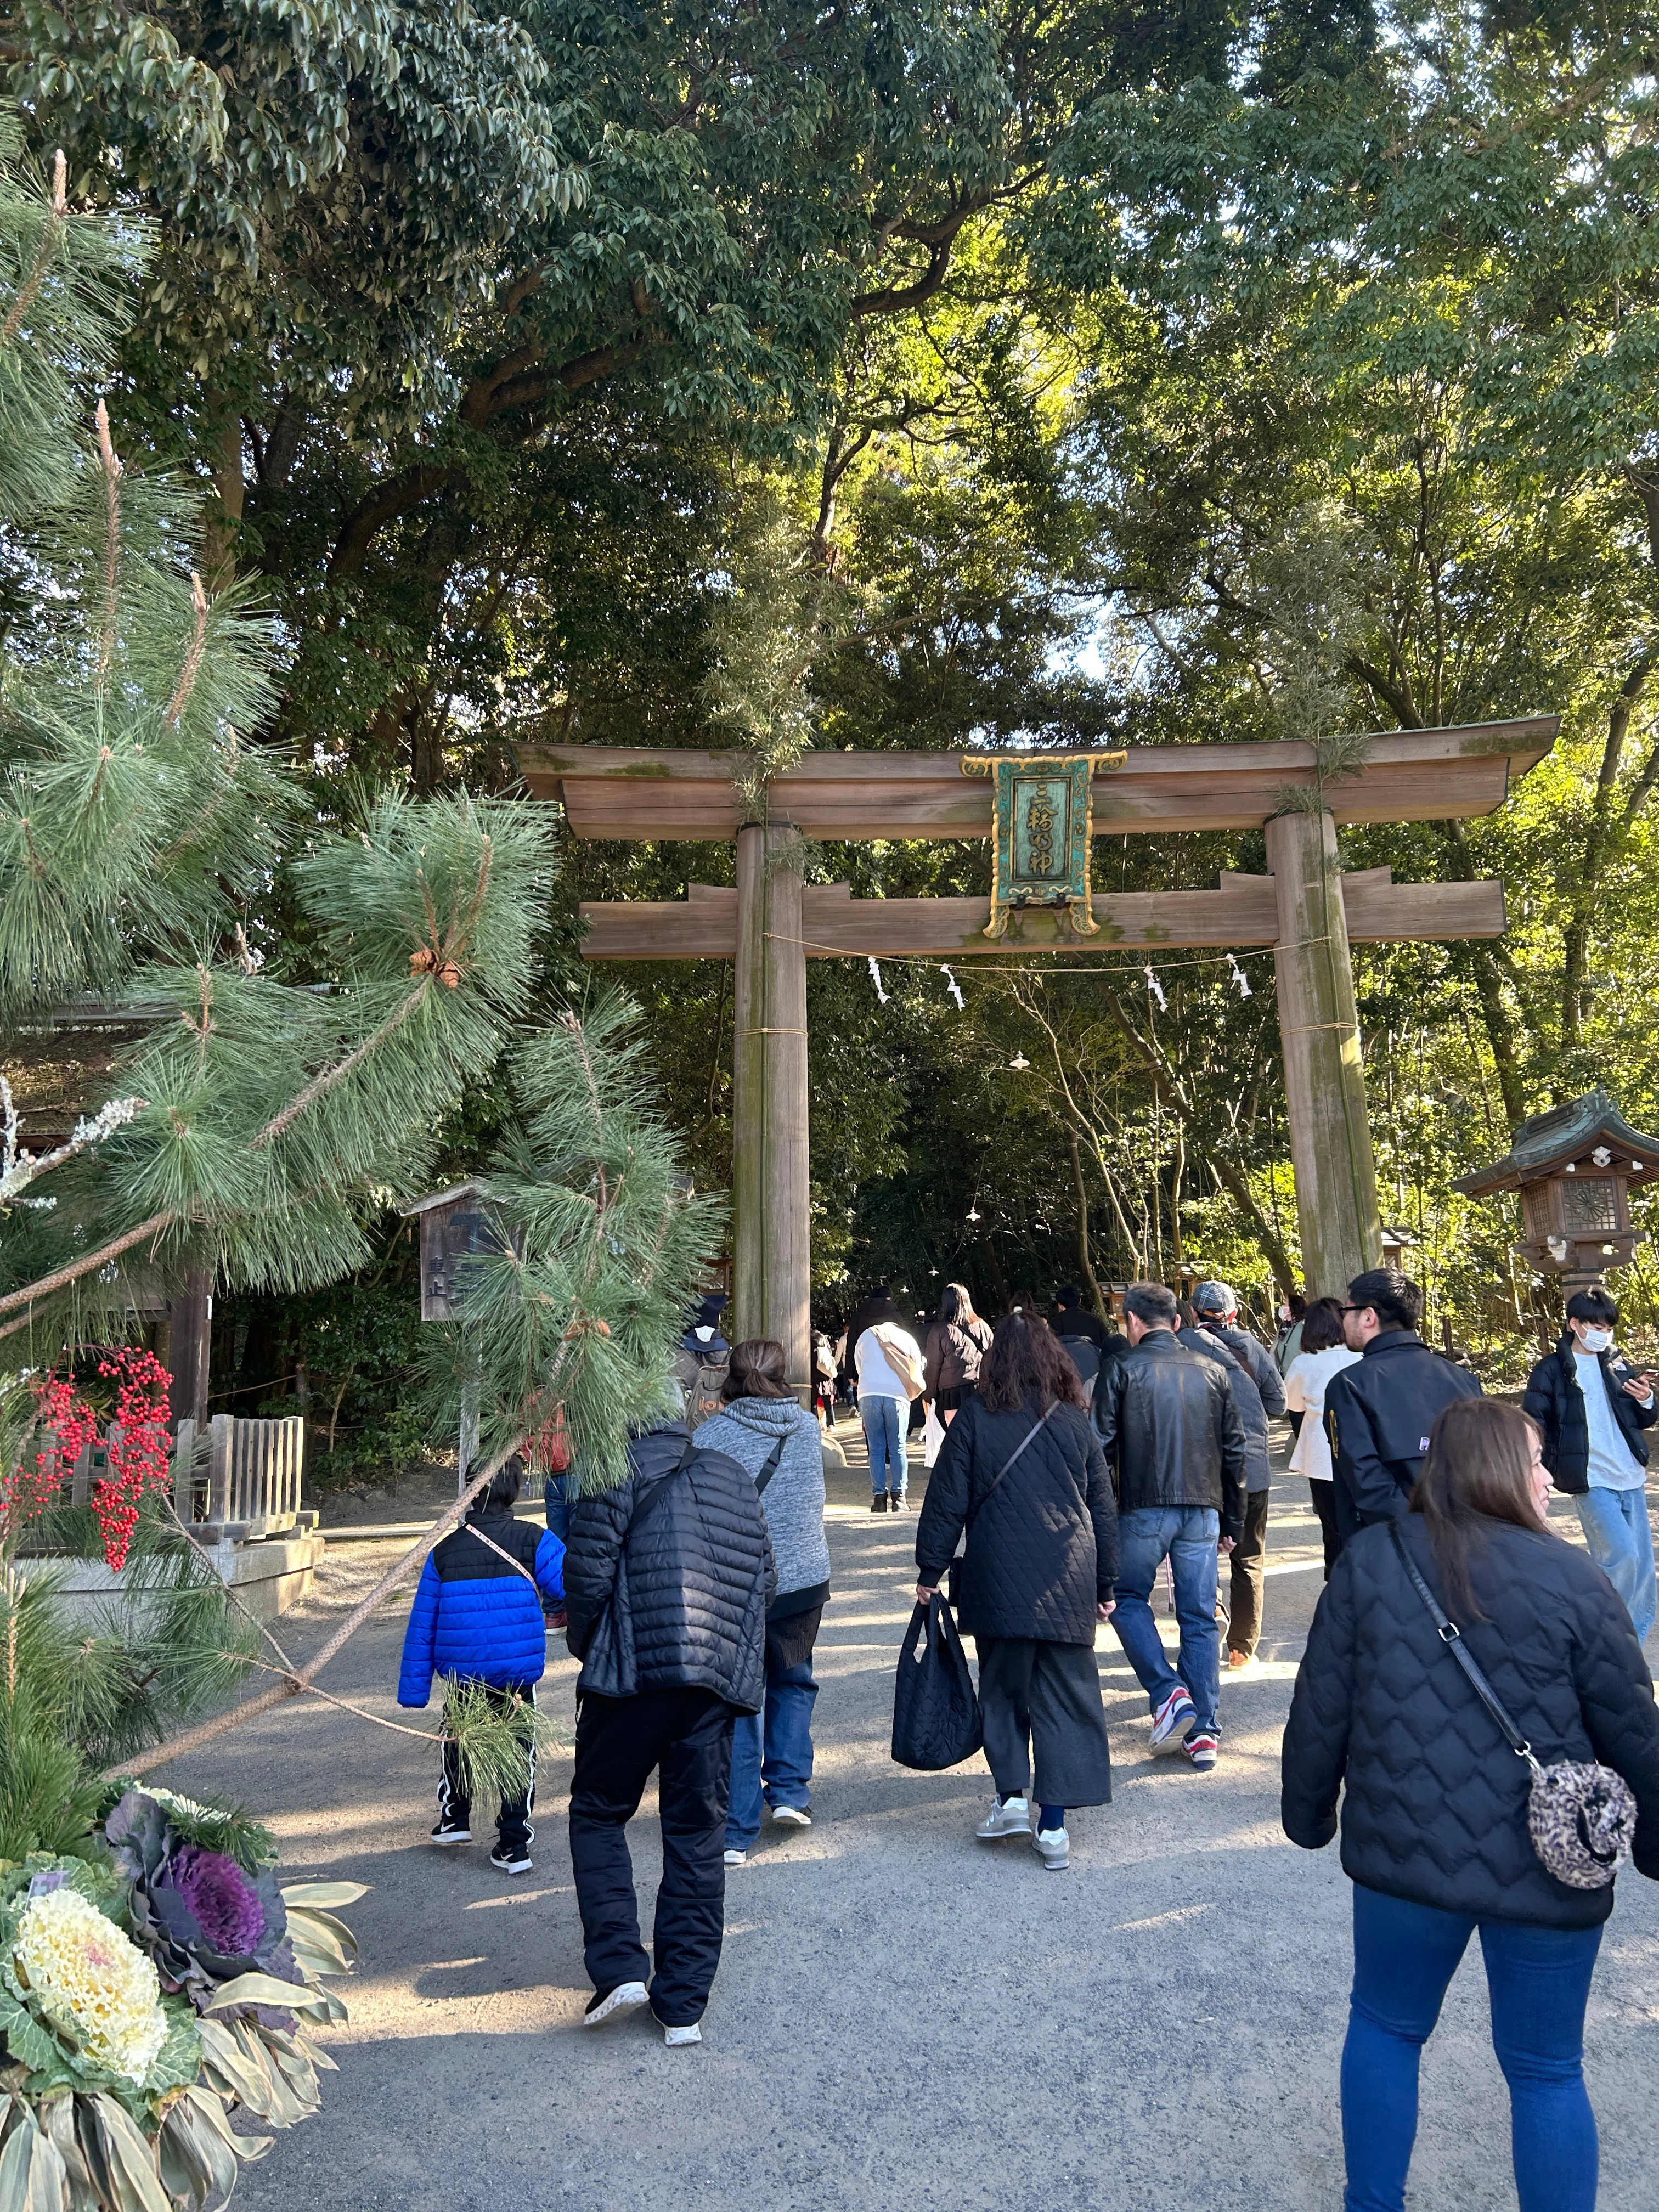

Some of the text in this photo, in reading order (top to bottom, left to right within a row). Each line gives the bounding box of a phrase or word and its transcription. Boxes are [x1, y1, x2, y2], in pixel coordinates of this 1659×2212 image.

[1027, 783, 1058, 876] 三輪明神
[426, 1257, 447, 1299] 車止
